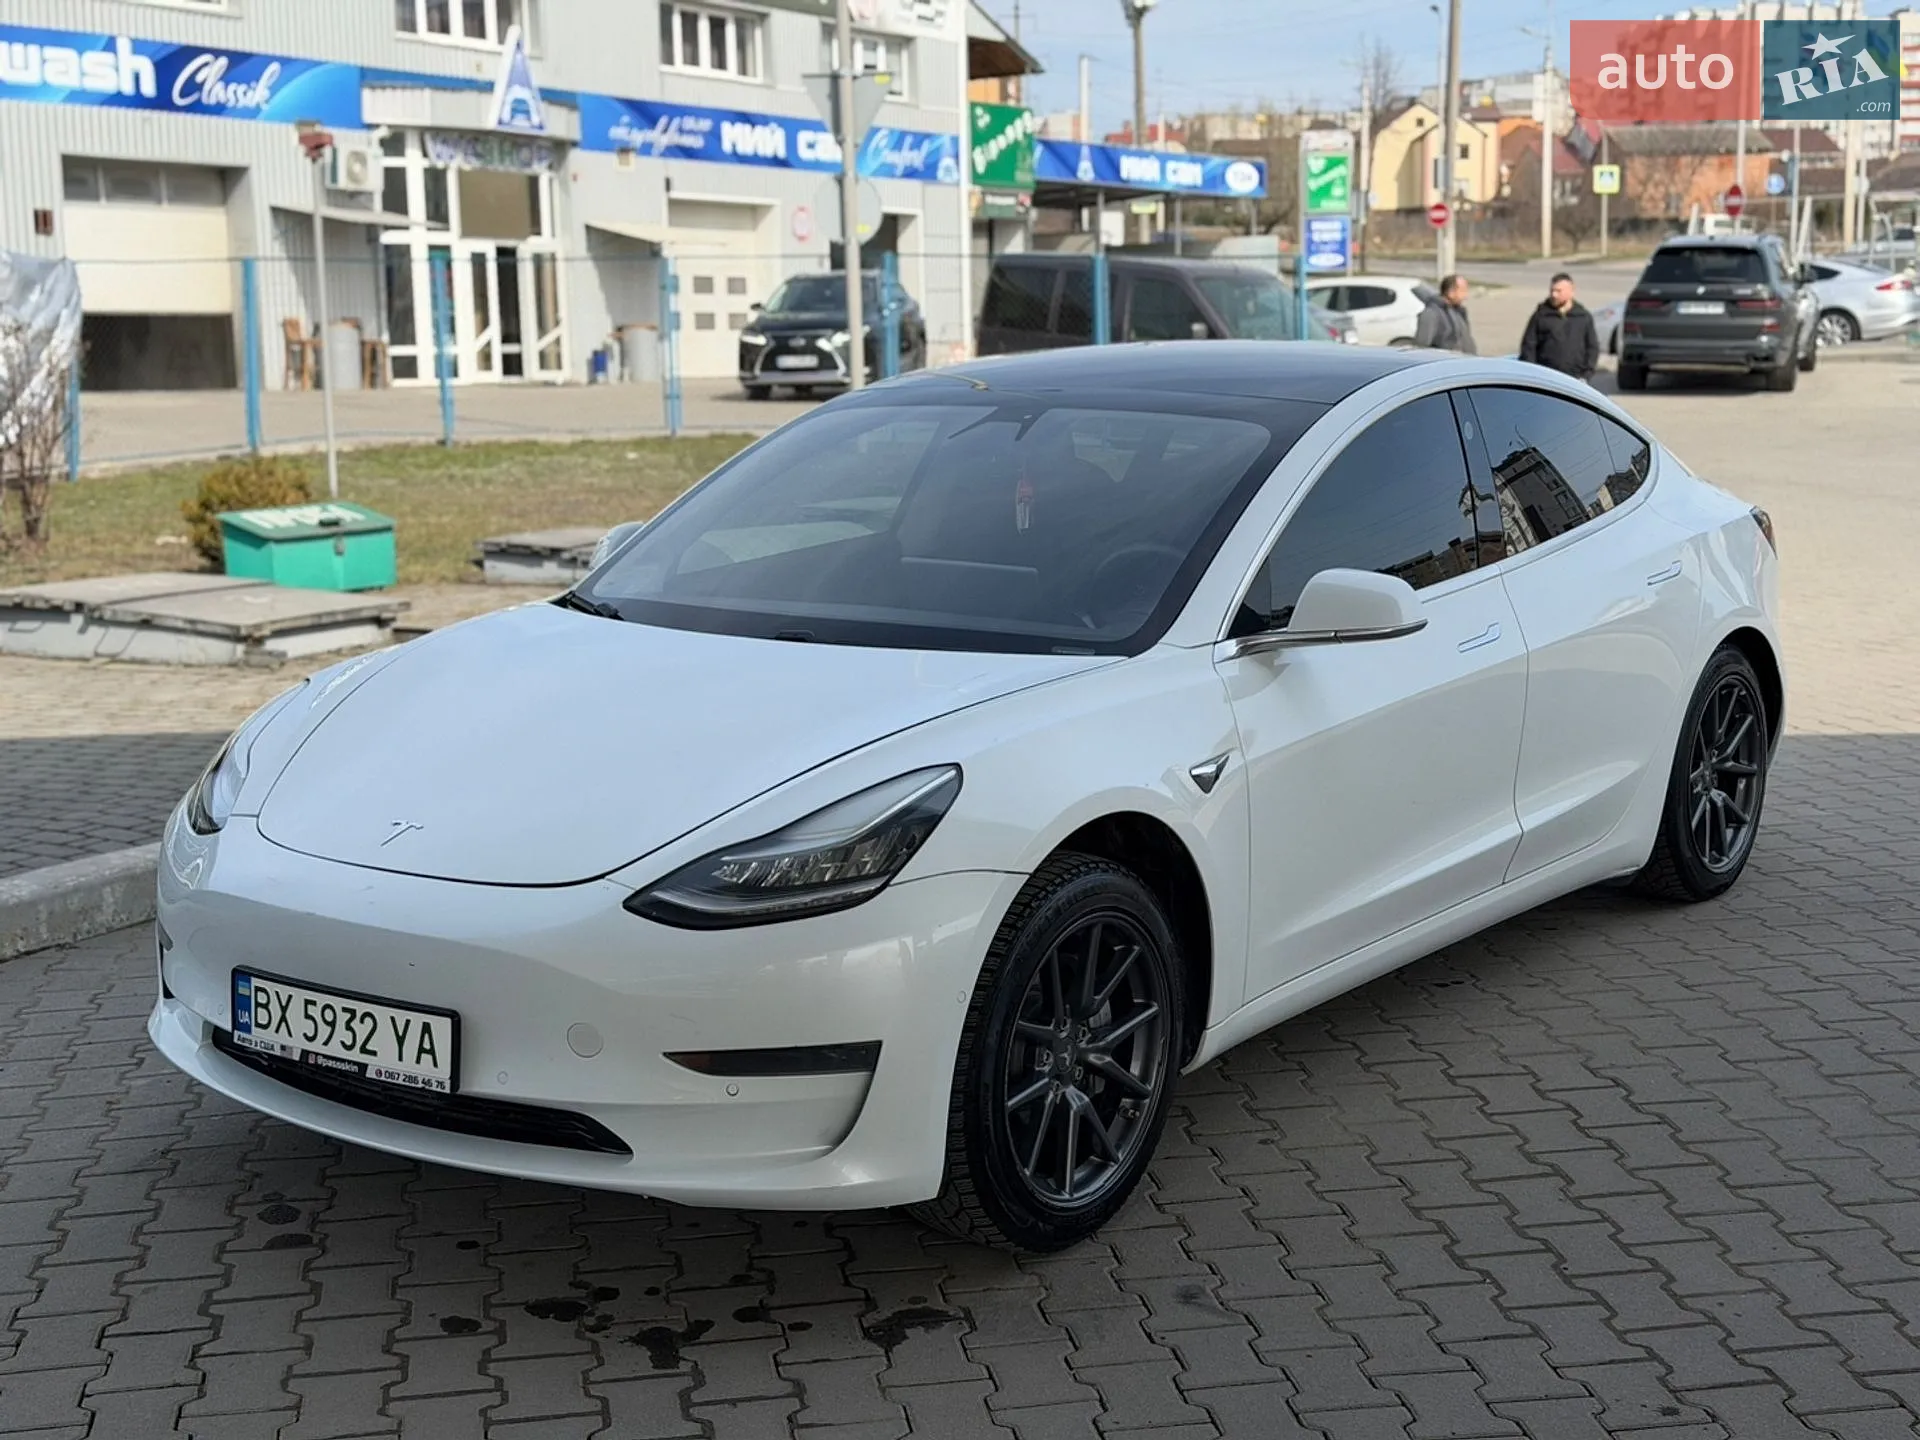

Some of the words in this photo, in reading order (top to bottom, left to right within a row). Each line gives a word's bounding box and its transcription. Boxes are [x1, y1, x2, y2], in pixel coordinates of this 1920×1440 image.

[0, 36, 157, 98] wash
[172, 53, 281, 110] Classik
[238, 1008, 251, 1025] UA
[254, 985, 293, 1039] BX
[302, 998, 378, 1058] 5932
[389, 1015, 439, 1069] YA
[384, 1069, 401, 1081] 067
